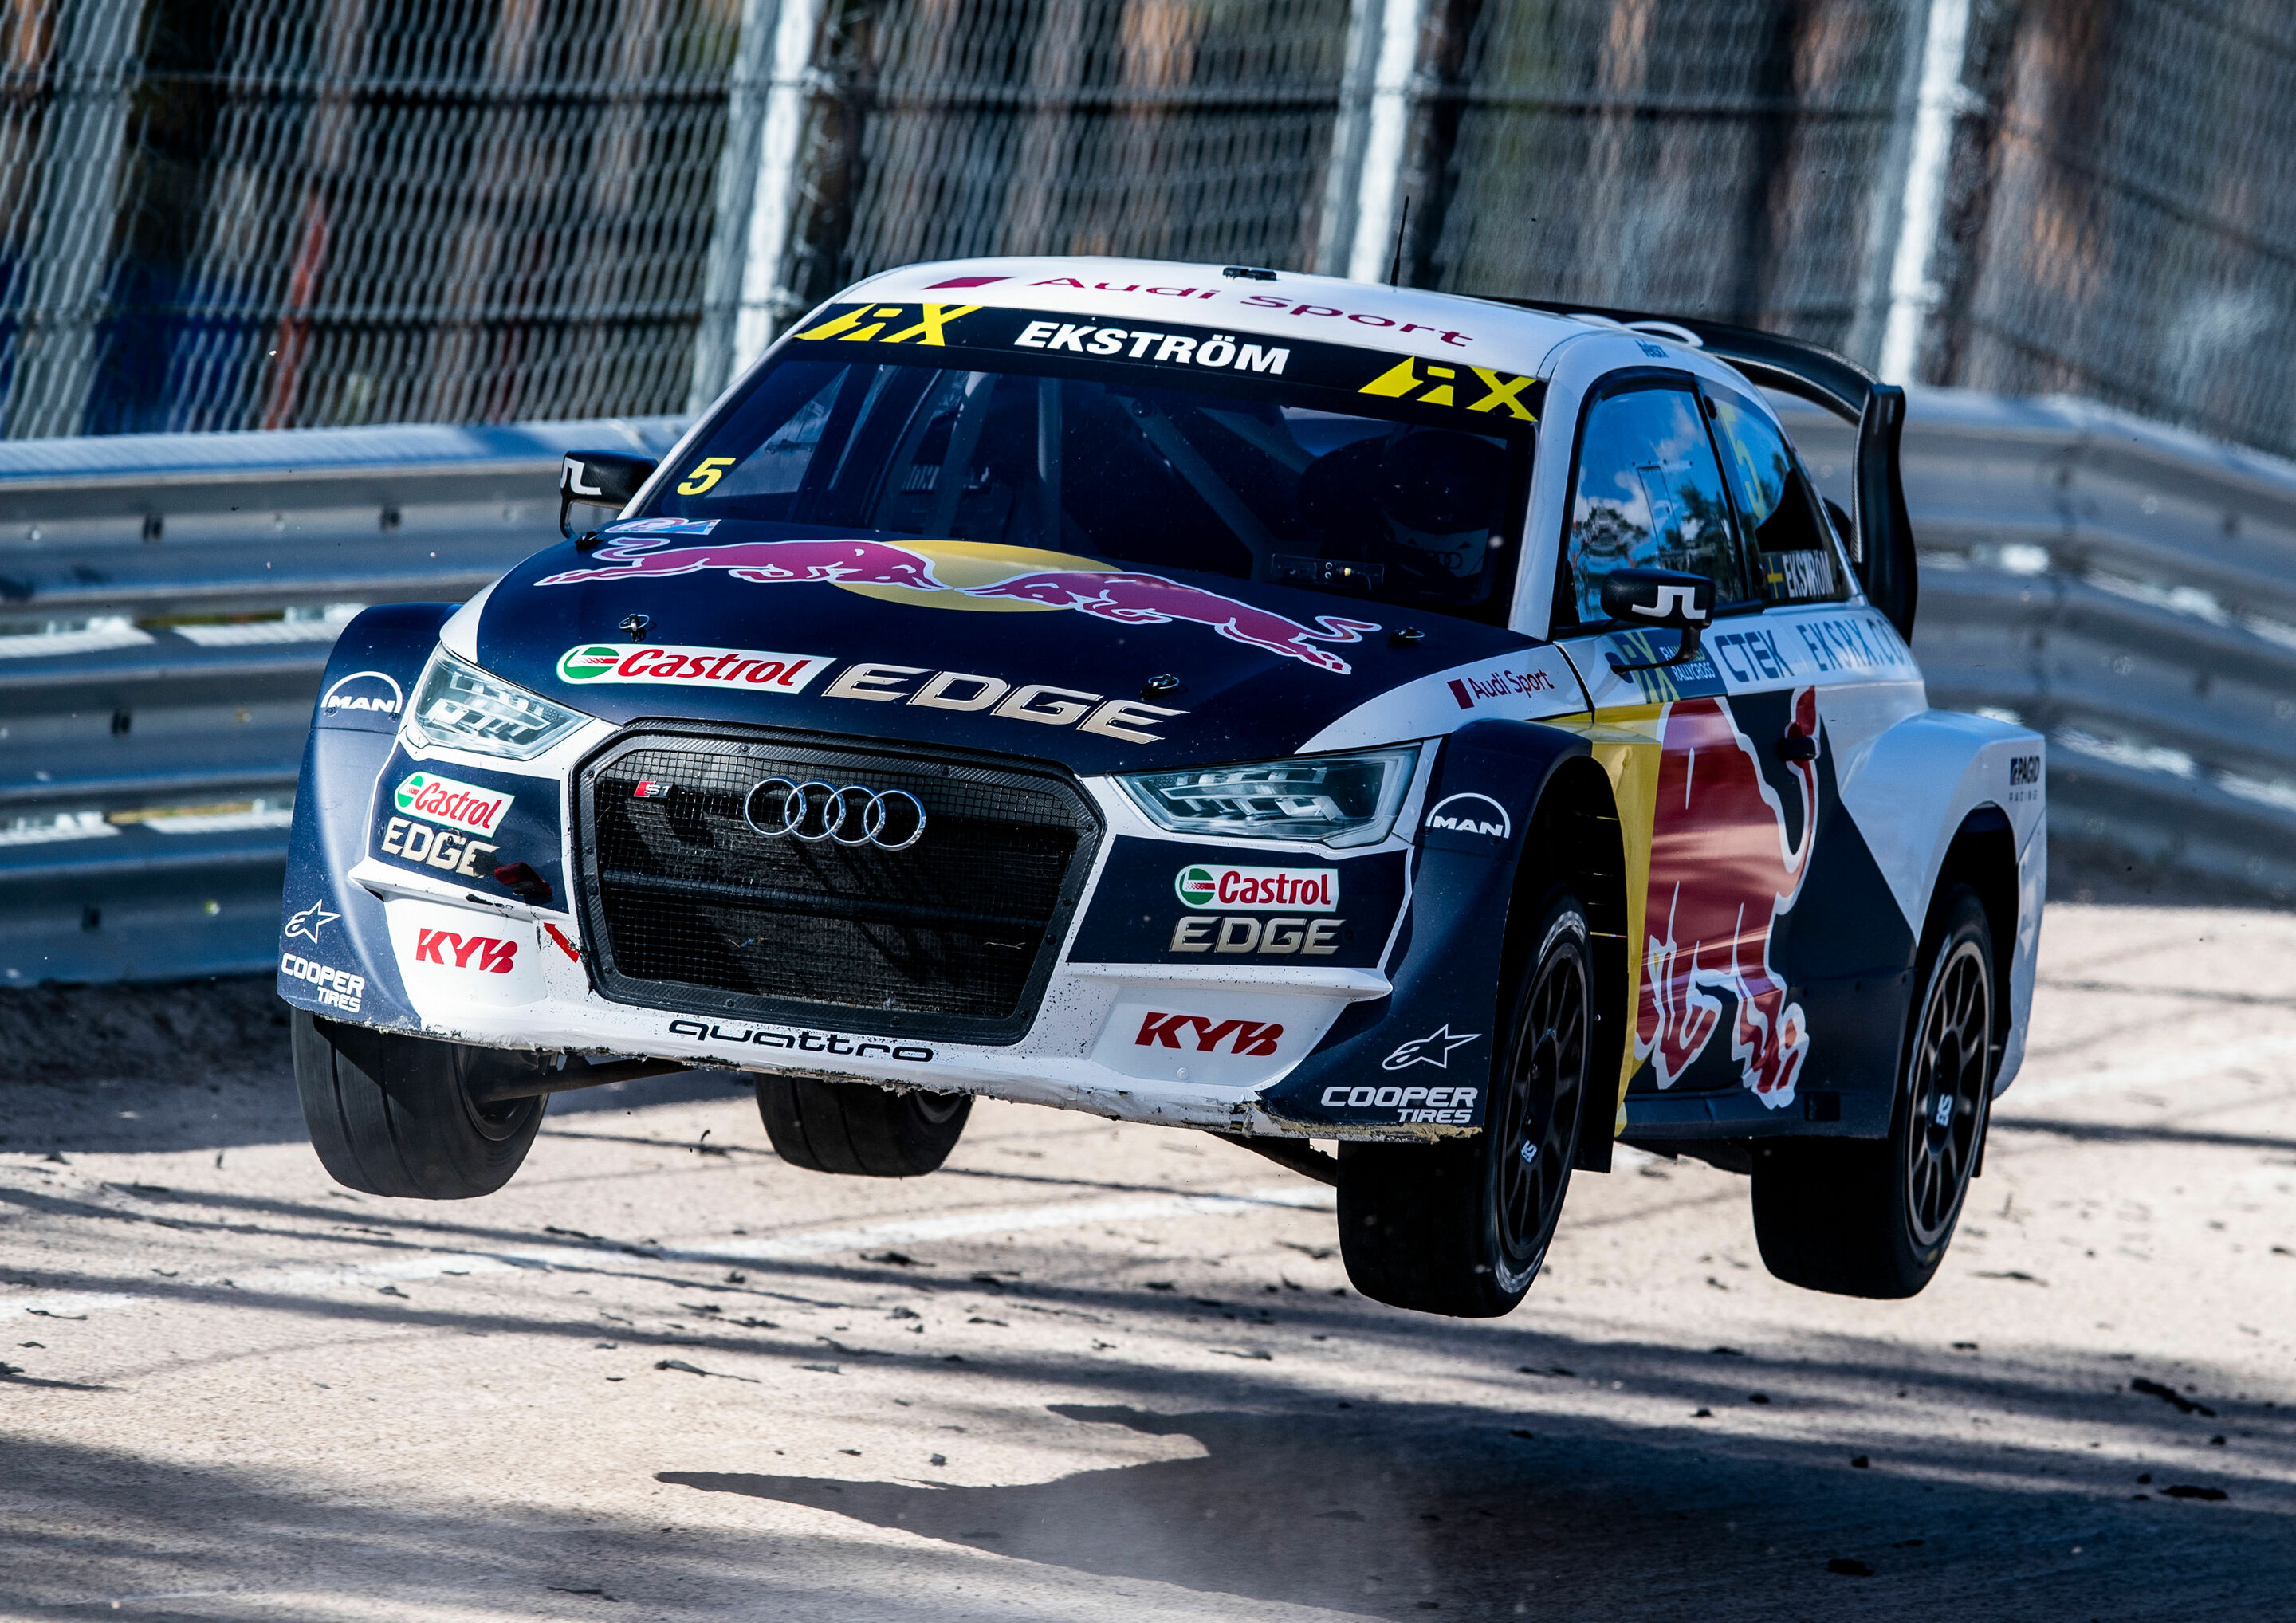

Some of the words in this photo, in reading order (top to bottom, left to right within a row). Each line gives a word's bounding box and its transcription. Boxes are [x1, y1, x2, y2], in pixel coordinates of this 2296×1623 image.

[1028, 277, 1220, 301] Audi
[1240, 294, 1474, 348] Sport
[1013, 320, 1291, 375] EKSTRÖM
[676, 457, 737, 495] 5
[1782, 549, 1834, 598] EKSTRÖM
[1670, 662, 1716, 682] RALLYCROSS
[1714, 629, 1795, 683] CTEK
[328, 695, 397, 712] MAN
[618, 649, 812, 686] Castrol
[821, 662, 1191, 745] EDGE
[1467, 672, 1512, 699] Audi
[1504, 669, 1555, 698] Sport
[415, 782, 503, 829] Castrol
[644, 784, 670, 796] S1
[1433, 815, 1504, 837] MAN
[381, 816, 501, 879] EDGE
[1218, 870, 1331, 906] Castrol
[415, 928, 518, 974] KYB
[1169, 916, 1347, 955] EDGE
[281, 953, 365, 998] COOPER
[316, 985, 362, 1013] TIRES
[669, 1019, 934, 1063] quattro
[1134, 1012, 1284, 1057] KYB
[1320, 1086, 1479, 1107] COOPER
[1397, 1108, 1474, 1124] TIRES
